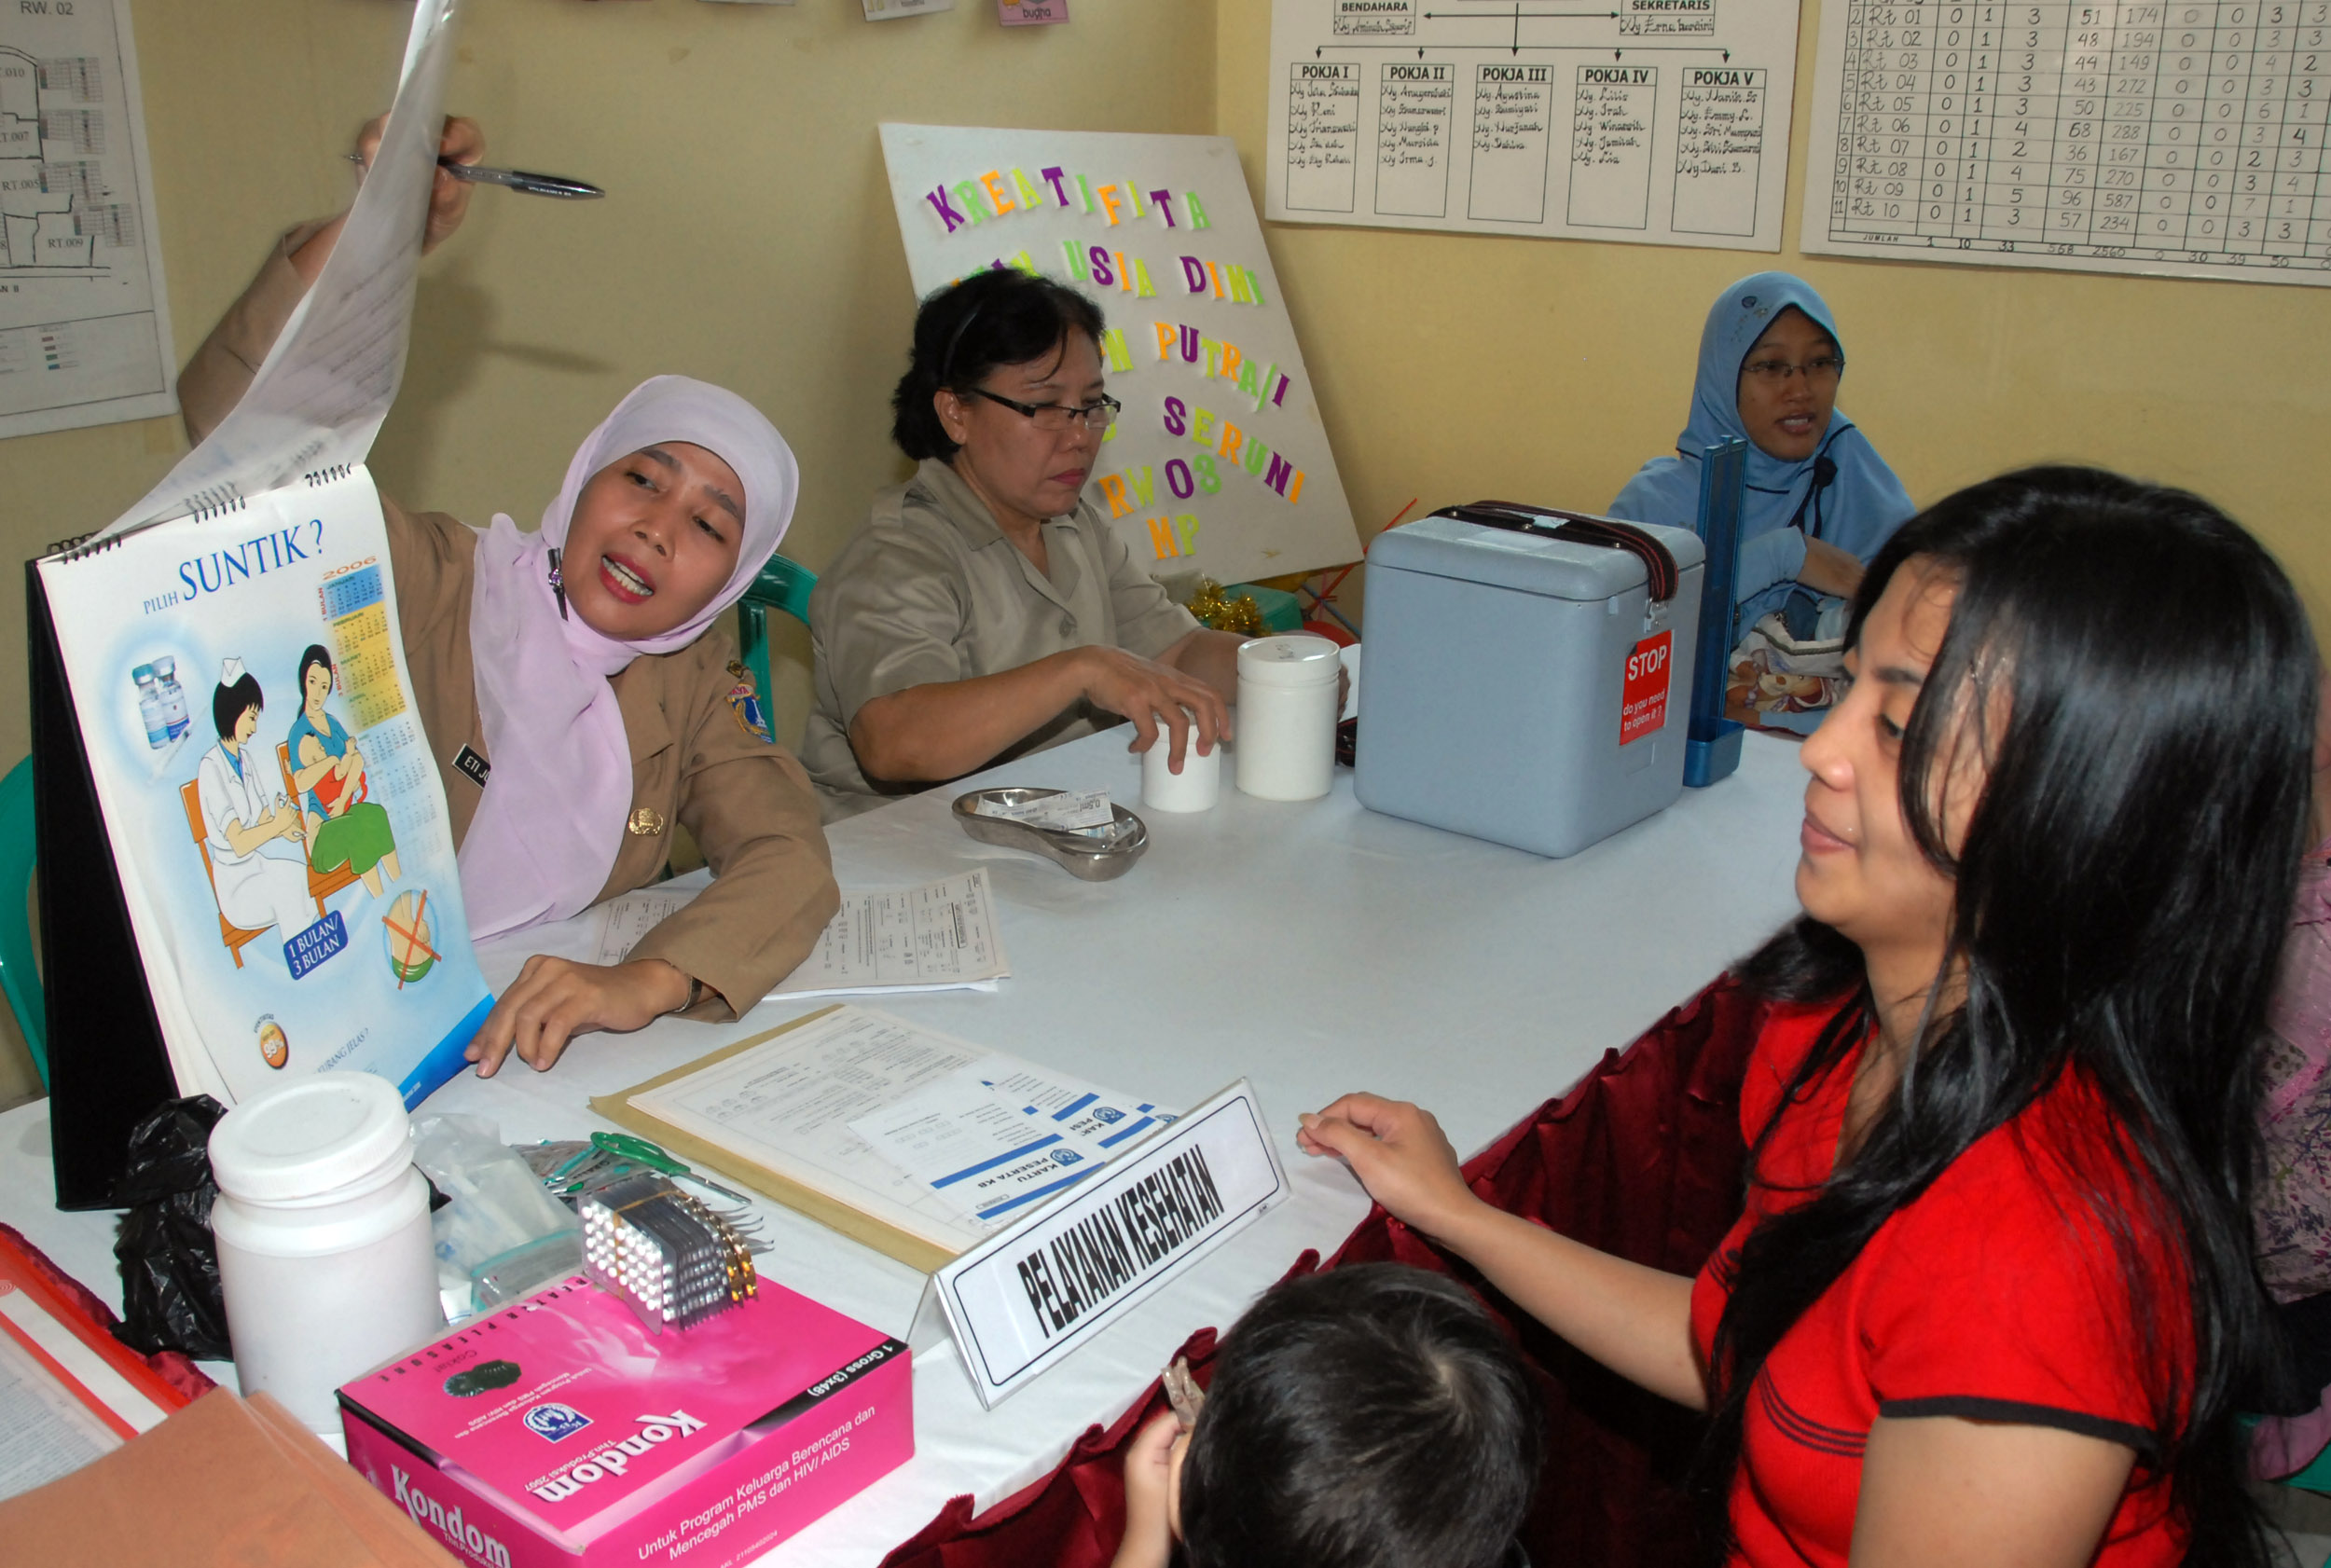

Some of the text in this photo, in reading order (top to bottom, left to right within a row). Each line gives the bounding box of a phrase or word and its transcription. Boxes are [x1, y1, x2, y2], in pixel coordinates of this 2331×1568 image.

[21, 1, 74, 16] RW. 02
[1341, 2, 1409, 12] BENDAHARA
[1632, 0, 1710, 10] SEKRETARIS
[1869, 6, 2159, 26] Rt 01 51 174
[1644, 16, 1676, 34] Erna
[1867, 28, 2154, 48] Rt 02 48 194
[1302, 65, 1348, 78] POKJA I
[1390, 66, 1444, 80] POKJA II
[1862, 49, 2149, 71] Rt 03 44 149
[1483, 68, 1547, 82] POKJA III
[1585, 69, 1648, 84] POKJA IV
[1694, 71, 1754, 86] POKJA V
[1860, 70, 2146, 93] Rt 04 43 272
[1858, 92, 2145, 117] Rt 05 50 225
[1856, 115, 2141, 140] Rt 06 68 288
[1856, 136, 2138, 163] Rt 07 36 167
[1856, 158, 2134, 186] Rt 08 75 270
[926, 166, 1212, 233] KREATIFITA
[1855, 177, 2133, 208] Rt 09 96 587
[1851, 199, 2130, 231] Rt 10 57 234
[48, 238, 83, 249] RT.009
[1863, 233, 2126, 257] JUMLAH 10 33 2560
[1062, 241, 1157, 296] USIA
[1179, 255, 1265, 305] DINI
[1154, 322, 1290, 412] PUTRA/I
[1164, 396, 1305, 505] SERUNI
[1098, 465, 1154, 519] RW
[1146, 514, 1200, 560] MP
[143, 590, 179, 615] PILIH
[179, 525, 309, 600] SUNTIK
[323, 556, 377, 581] 2006
[318, 587, 327, 615] BULAN
[1628, 645, 1667, 681] STOP
[331, 663, 342, 692] BULAN
[1623, 688, 1666, 716] do you need
[1623, 721, 1632, 732] to
[1633, 712, 1649, 728] open
[1651, 708, 1657, 720] it
[463, 755, 481, 773] ETI
[288, 915, 338, 958] 1 BULAN/
[293, 934, 339, 976] 3 BULAN
[346, 1032, 366, 1055] JELAS
[977, 1157, 1049, 1189] PESERTA KB
[1017, 1163, 1059, 1184] KARTU
[1016, 1143, 1225, 1340] PELAYANAN KESEHATAN
[807, 1343, 893, 1396] 1 Gross (3x48)
[531, 1409, 708, 1503] Kondom
[524, 1475, 550, 1492] 2007
[638, 1529, 677, 1561] Untuk
[680, 1495, 735, 1536] Program
[736, 1462, 790, 1499] Keluarga
[792, 1420, 853, 1466] Berencana
[855, 1406, 876, 1426] dan
[669, 1511, 735, 1561] Mencegah
[738, 1492, 767, 1519] PMS
[769, 1476, 792, 1498] dan
[794, 1460, 820, 1483] HIV/
[821, 1437, 851, 1465] AIDS
[391, 1464, 513, 1568] Kondom
